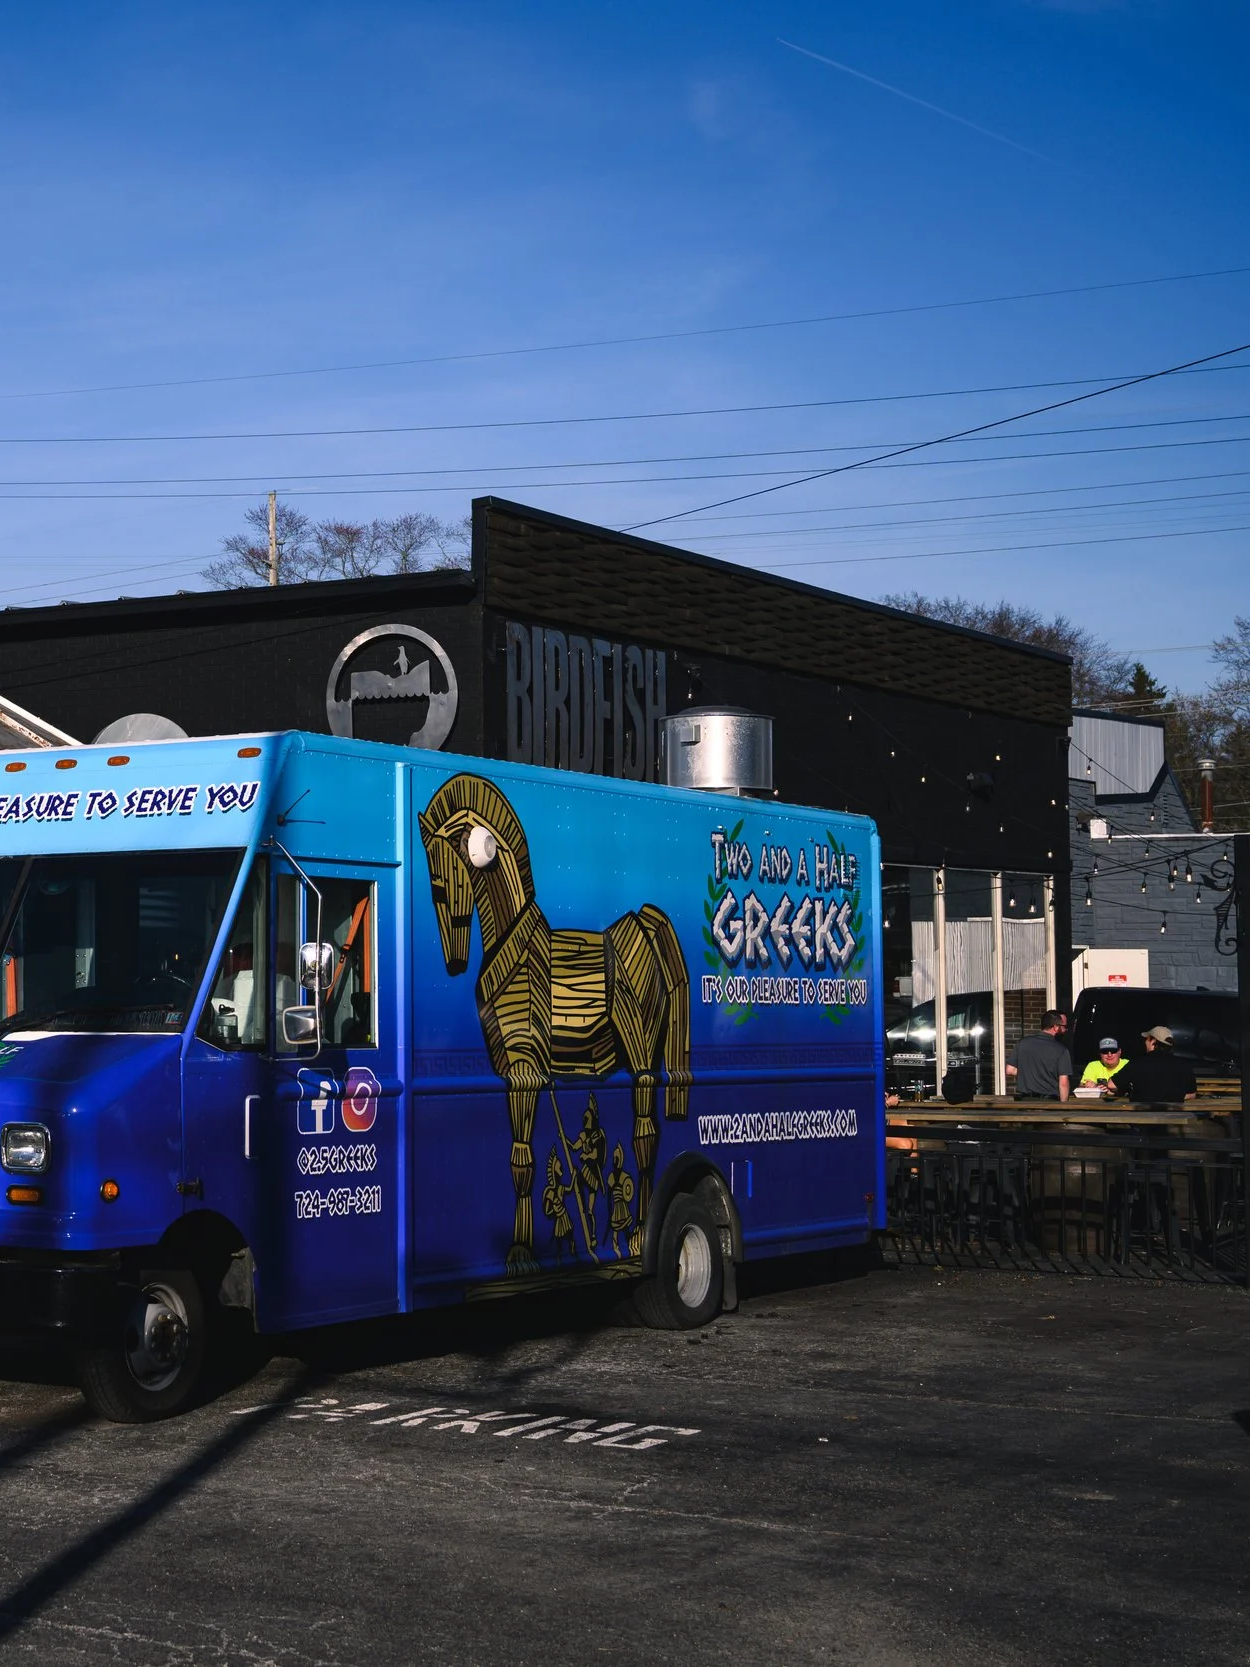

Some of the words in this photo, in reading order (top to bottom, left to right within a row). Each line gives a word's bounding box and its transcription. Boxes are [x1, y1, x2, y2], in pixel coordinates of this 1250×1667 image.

[506, 621, 667, 784] BIRDFISH
[86, 790, 120, 818] TO
[121, 786, 199, 817] SERVE
[205, 781, 261, 812] YOU
[759, 844, 792, 884] AND
[711, 888, 858, 973] GREEKS
[702, 976, 723, 1003] IT'S
[725, 976, 749, 1003] OUR
[751, 977, 799, 1004] PLEASURE
[800, 978, 815, 1004] TO
[818, 979, 845, 1004] SERVE
[847, 979, 868, 1005] YOU
[698, 1109, 857, 1144] WWW.2ANDAHALFGREEKS.COM
[295, 1185, 381, 1218] 724-987-3211
